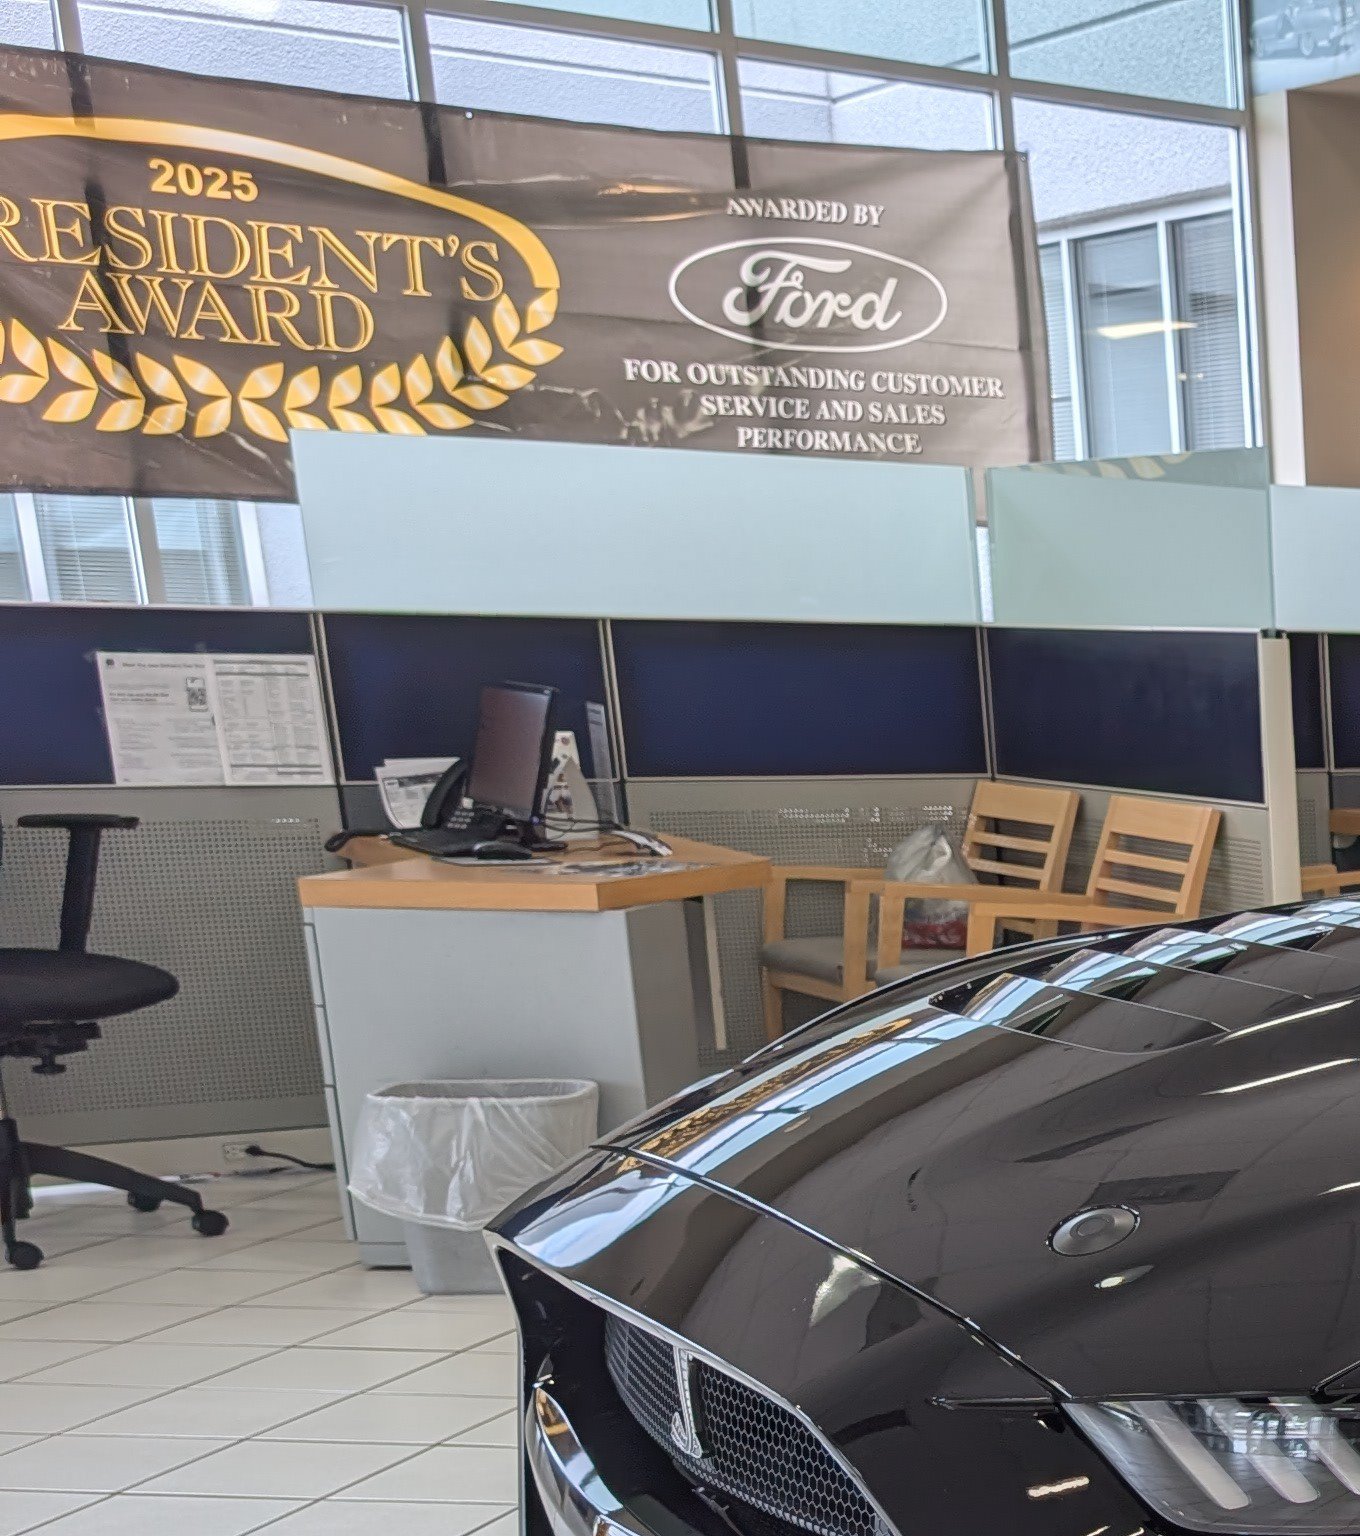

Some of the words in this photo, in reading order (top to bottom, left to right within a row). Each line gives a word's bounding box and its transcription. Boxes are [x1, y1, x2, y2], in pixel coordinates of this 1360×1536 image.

[149, 158, 259, 202] 2025
[726, 198, 848, 224] AWARDED
[853, 204, 885, 227] BY
[58, 269, 377, 353] AWARD
[722, 250, 902, 332] Ford
[623, 357, 682, 384] FOR
[686, 362, 866, 393] OUTSTANDING
[870, 371, 1006, 399] CUSTOMER
[700, 395, 810, 421] SERVICE
[816, 400, 864, 424] AND
[867, 403, 948, 426] SALES
[736, 426, 924, 454] PERFORMANCE
